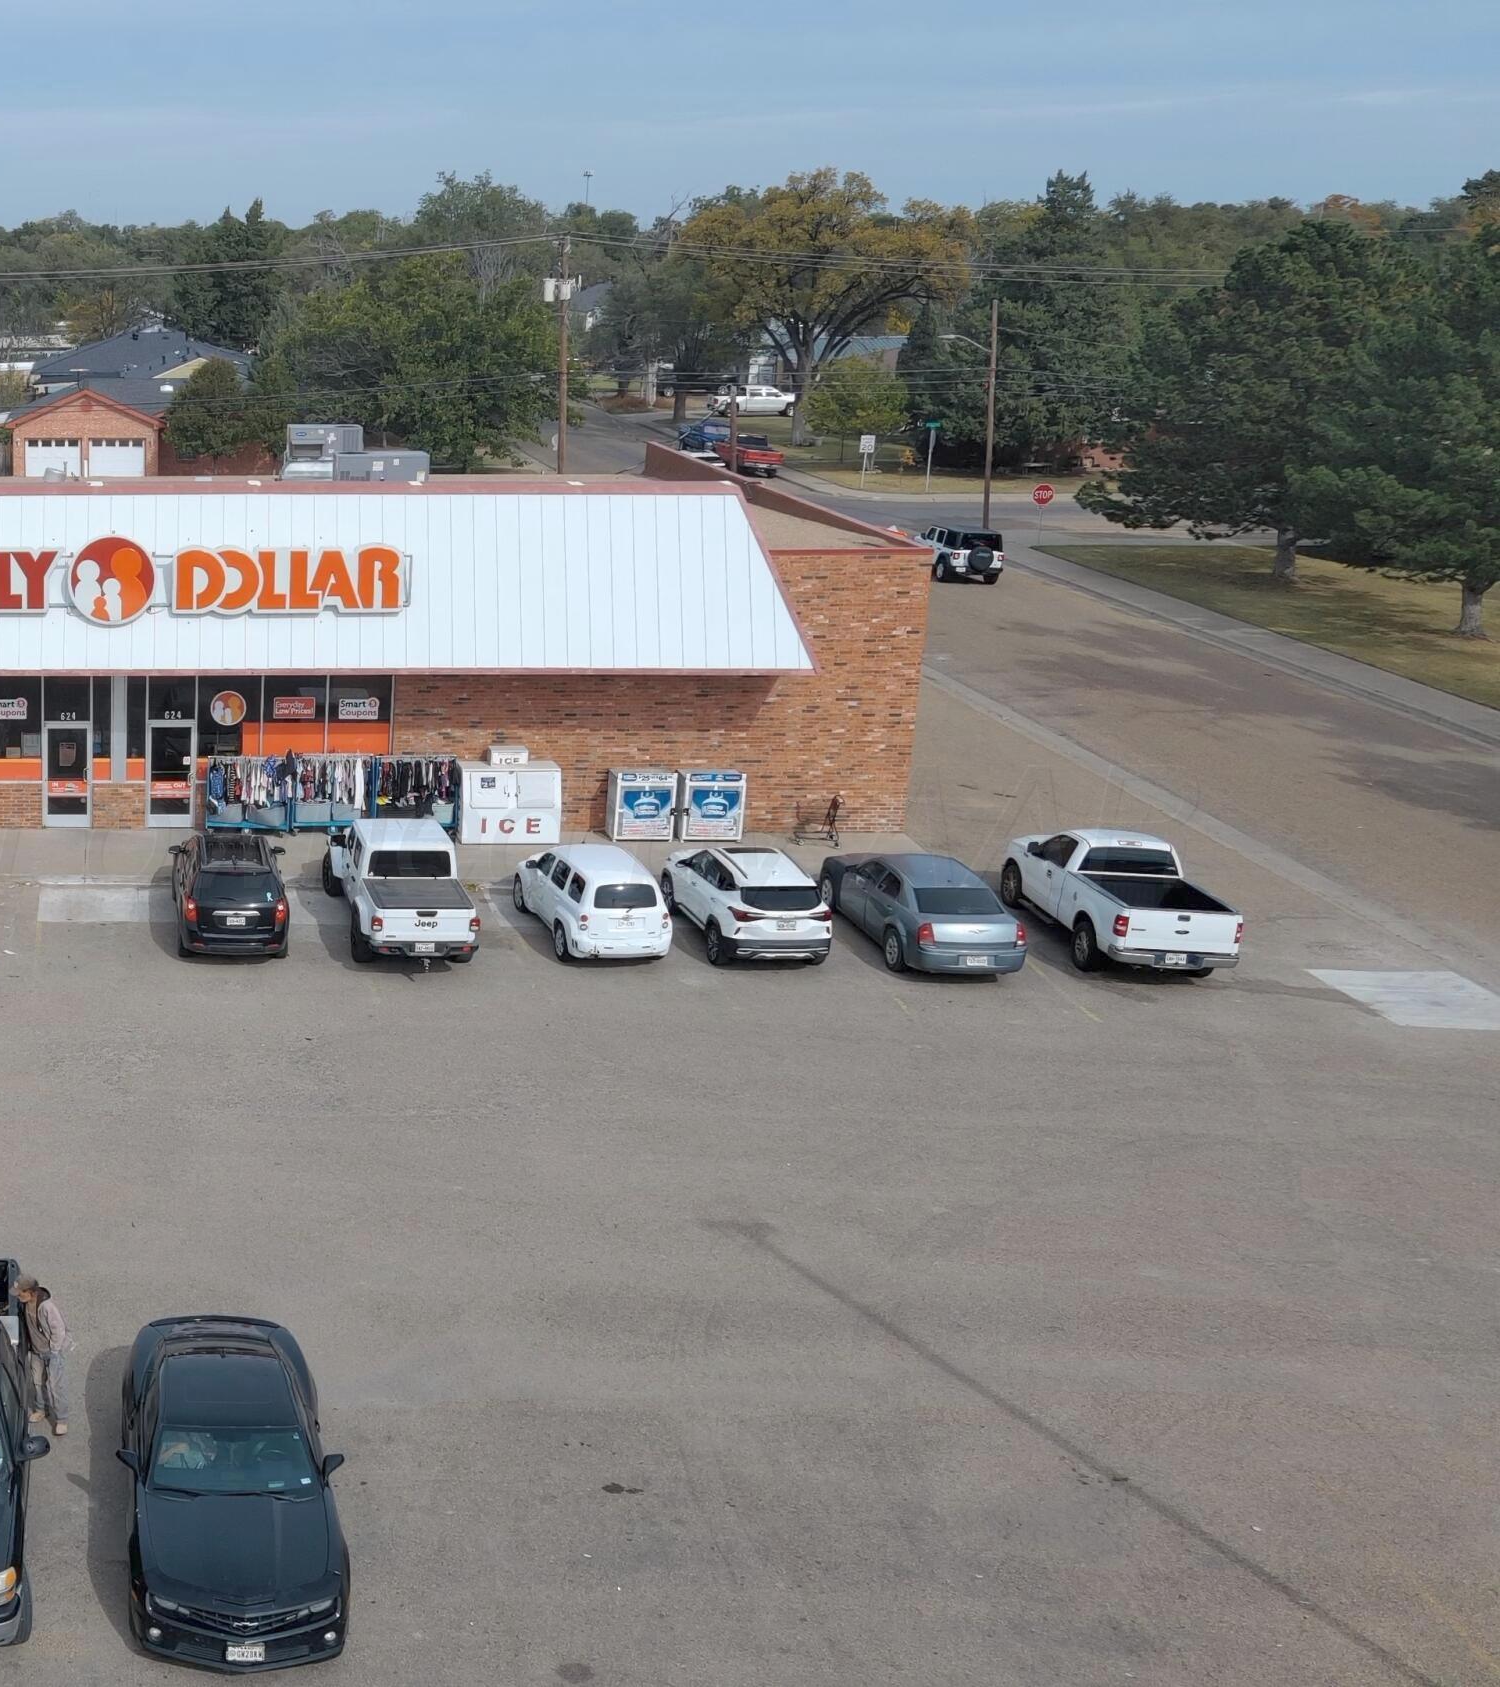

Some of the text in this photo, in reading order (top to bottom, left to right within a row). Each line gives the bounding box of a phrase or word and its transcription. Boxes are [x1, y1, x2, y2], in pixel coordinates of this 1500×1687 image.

[1034, 490, 1053, 499] STOP
[174, 546, 401, 610] DOLLAR
[275, 700, 306, 709] Everyday
[339, 700, 367, 708] Smart
[60, 711, 76, 721] 624
[164, 710, 182, 720] 624
[339, 708, 378, 717] Coupons
[480, 817, 542, 835] ICE
[414, 919, 438, 929] Jeep
